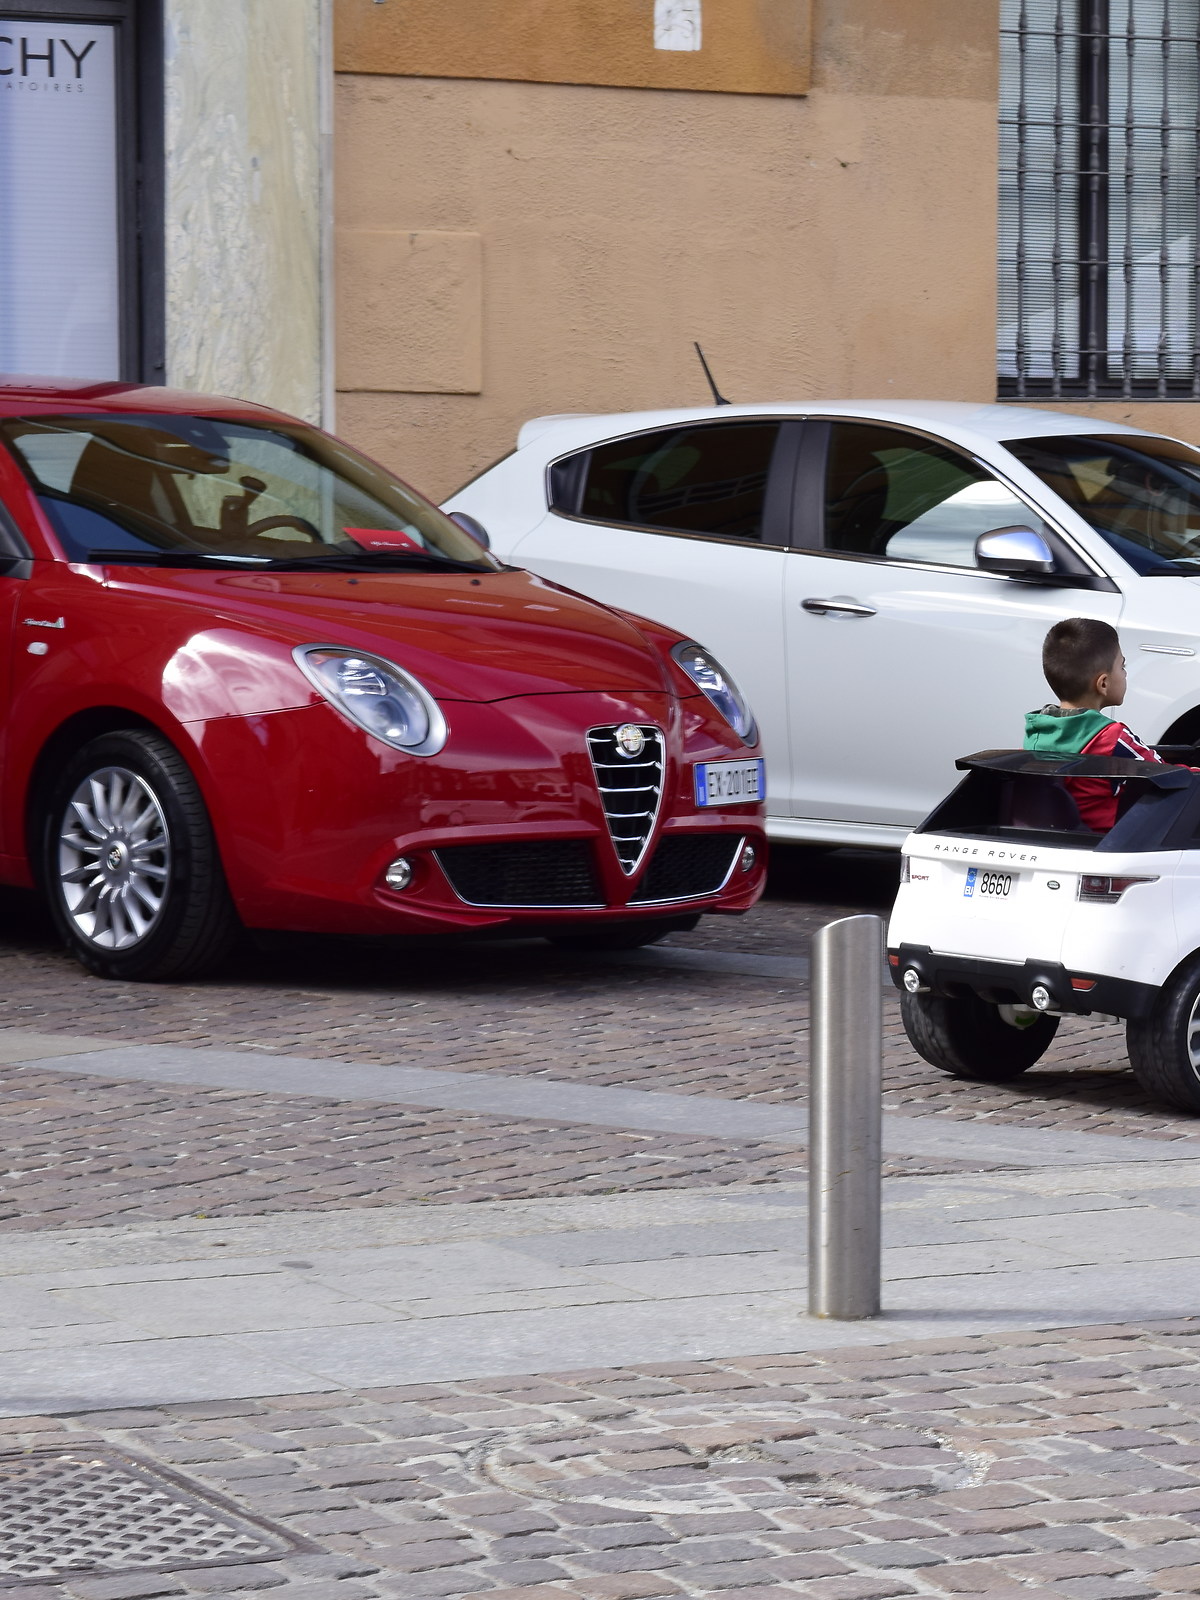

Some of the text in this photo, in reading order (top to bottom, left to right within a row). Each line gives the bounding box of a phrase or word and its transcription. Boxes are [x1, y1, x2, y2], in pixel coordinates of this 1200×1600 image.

[934, 844, 1038, 862] RANGE ROVER
[980, 872, 1012, 897] 8660
